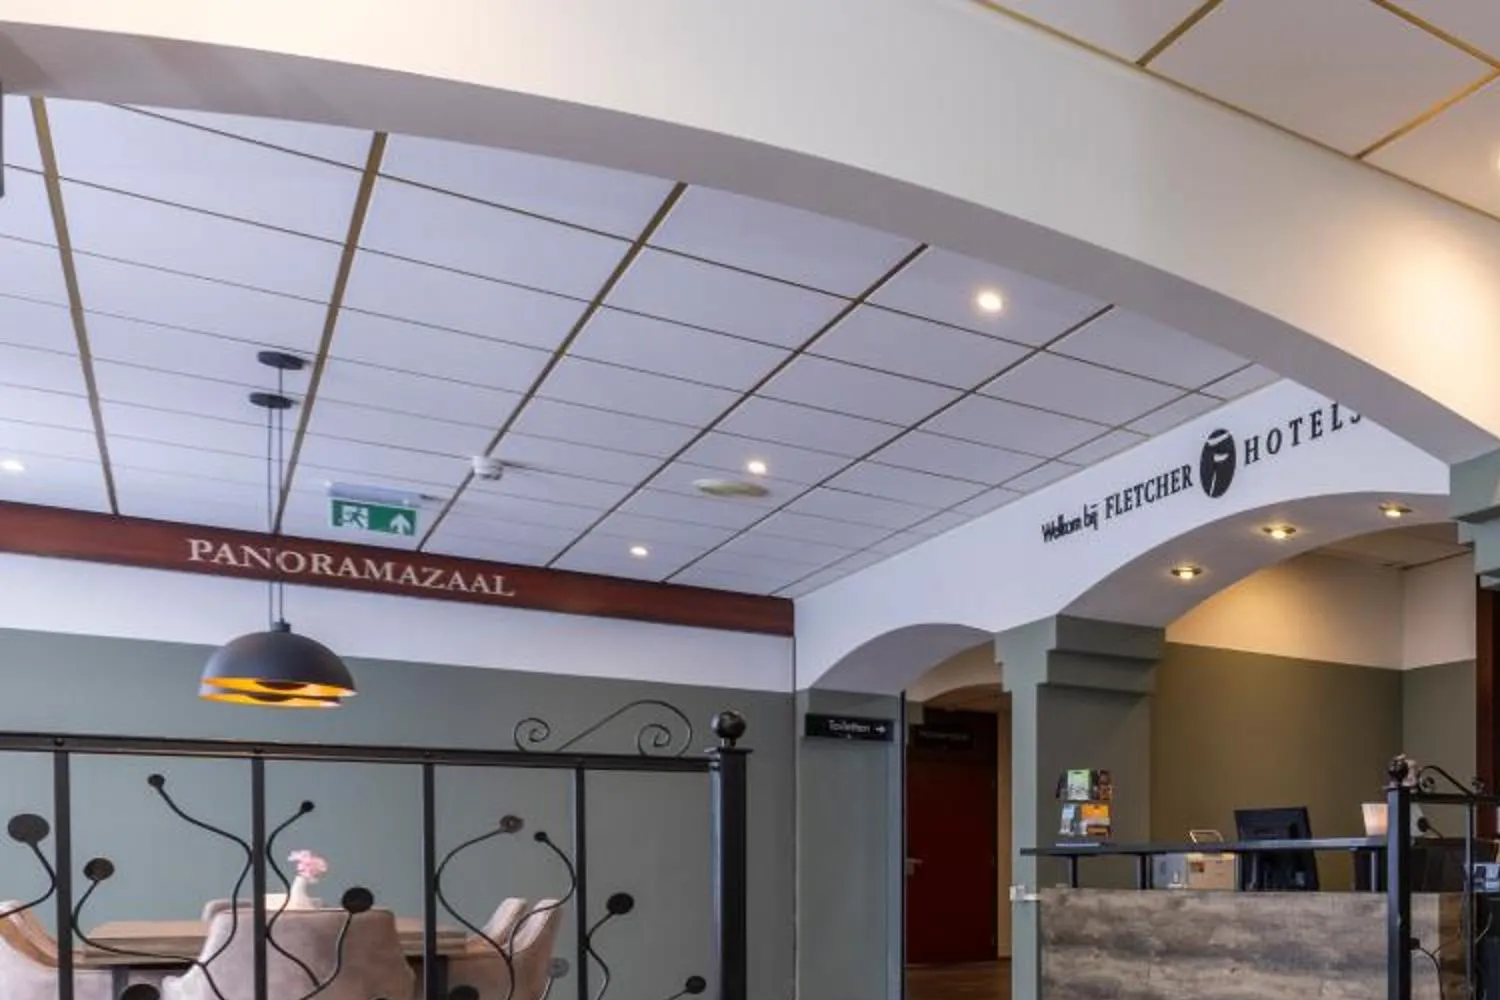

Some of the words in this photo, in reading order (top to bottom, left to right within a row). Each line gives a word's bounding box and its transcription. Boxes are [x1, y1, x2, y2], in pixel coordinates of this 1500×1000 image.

[1105, 464, 1193, 520] FLETCHER
[1244, 402, 1361, 467] HOTEL
[186, 538, 516, 597] PANORAMAZAAL
